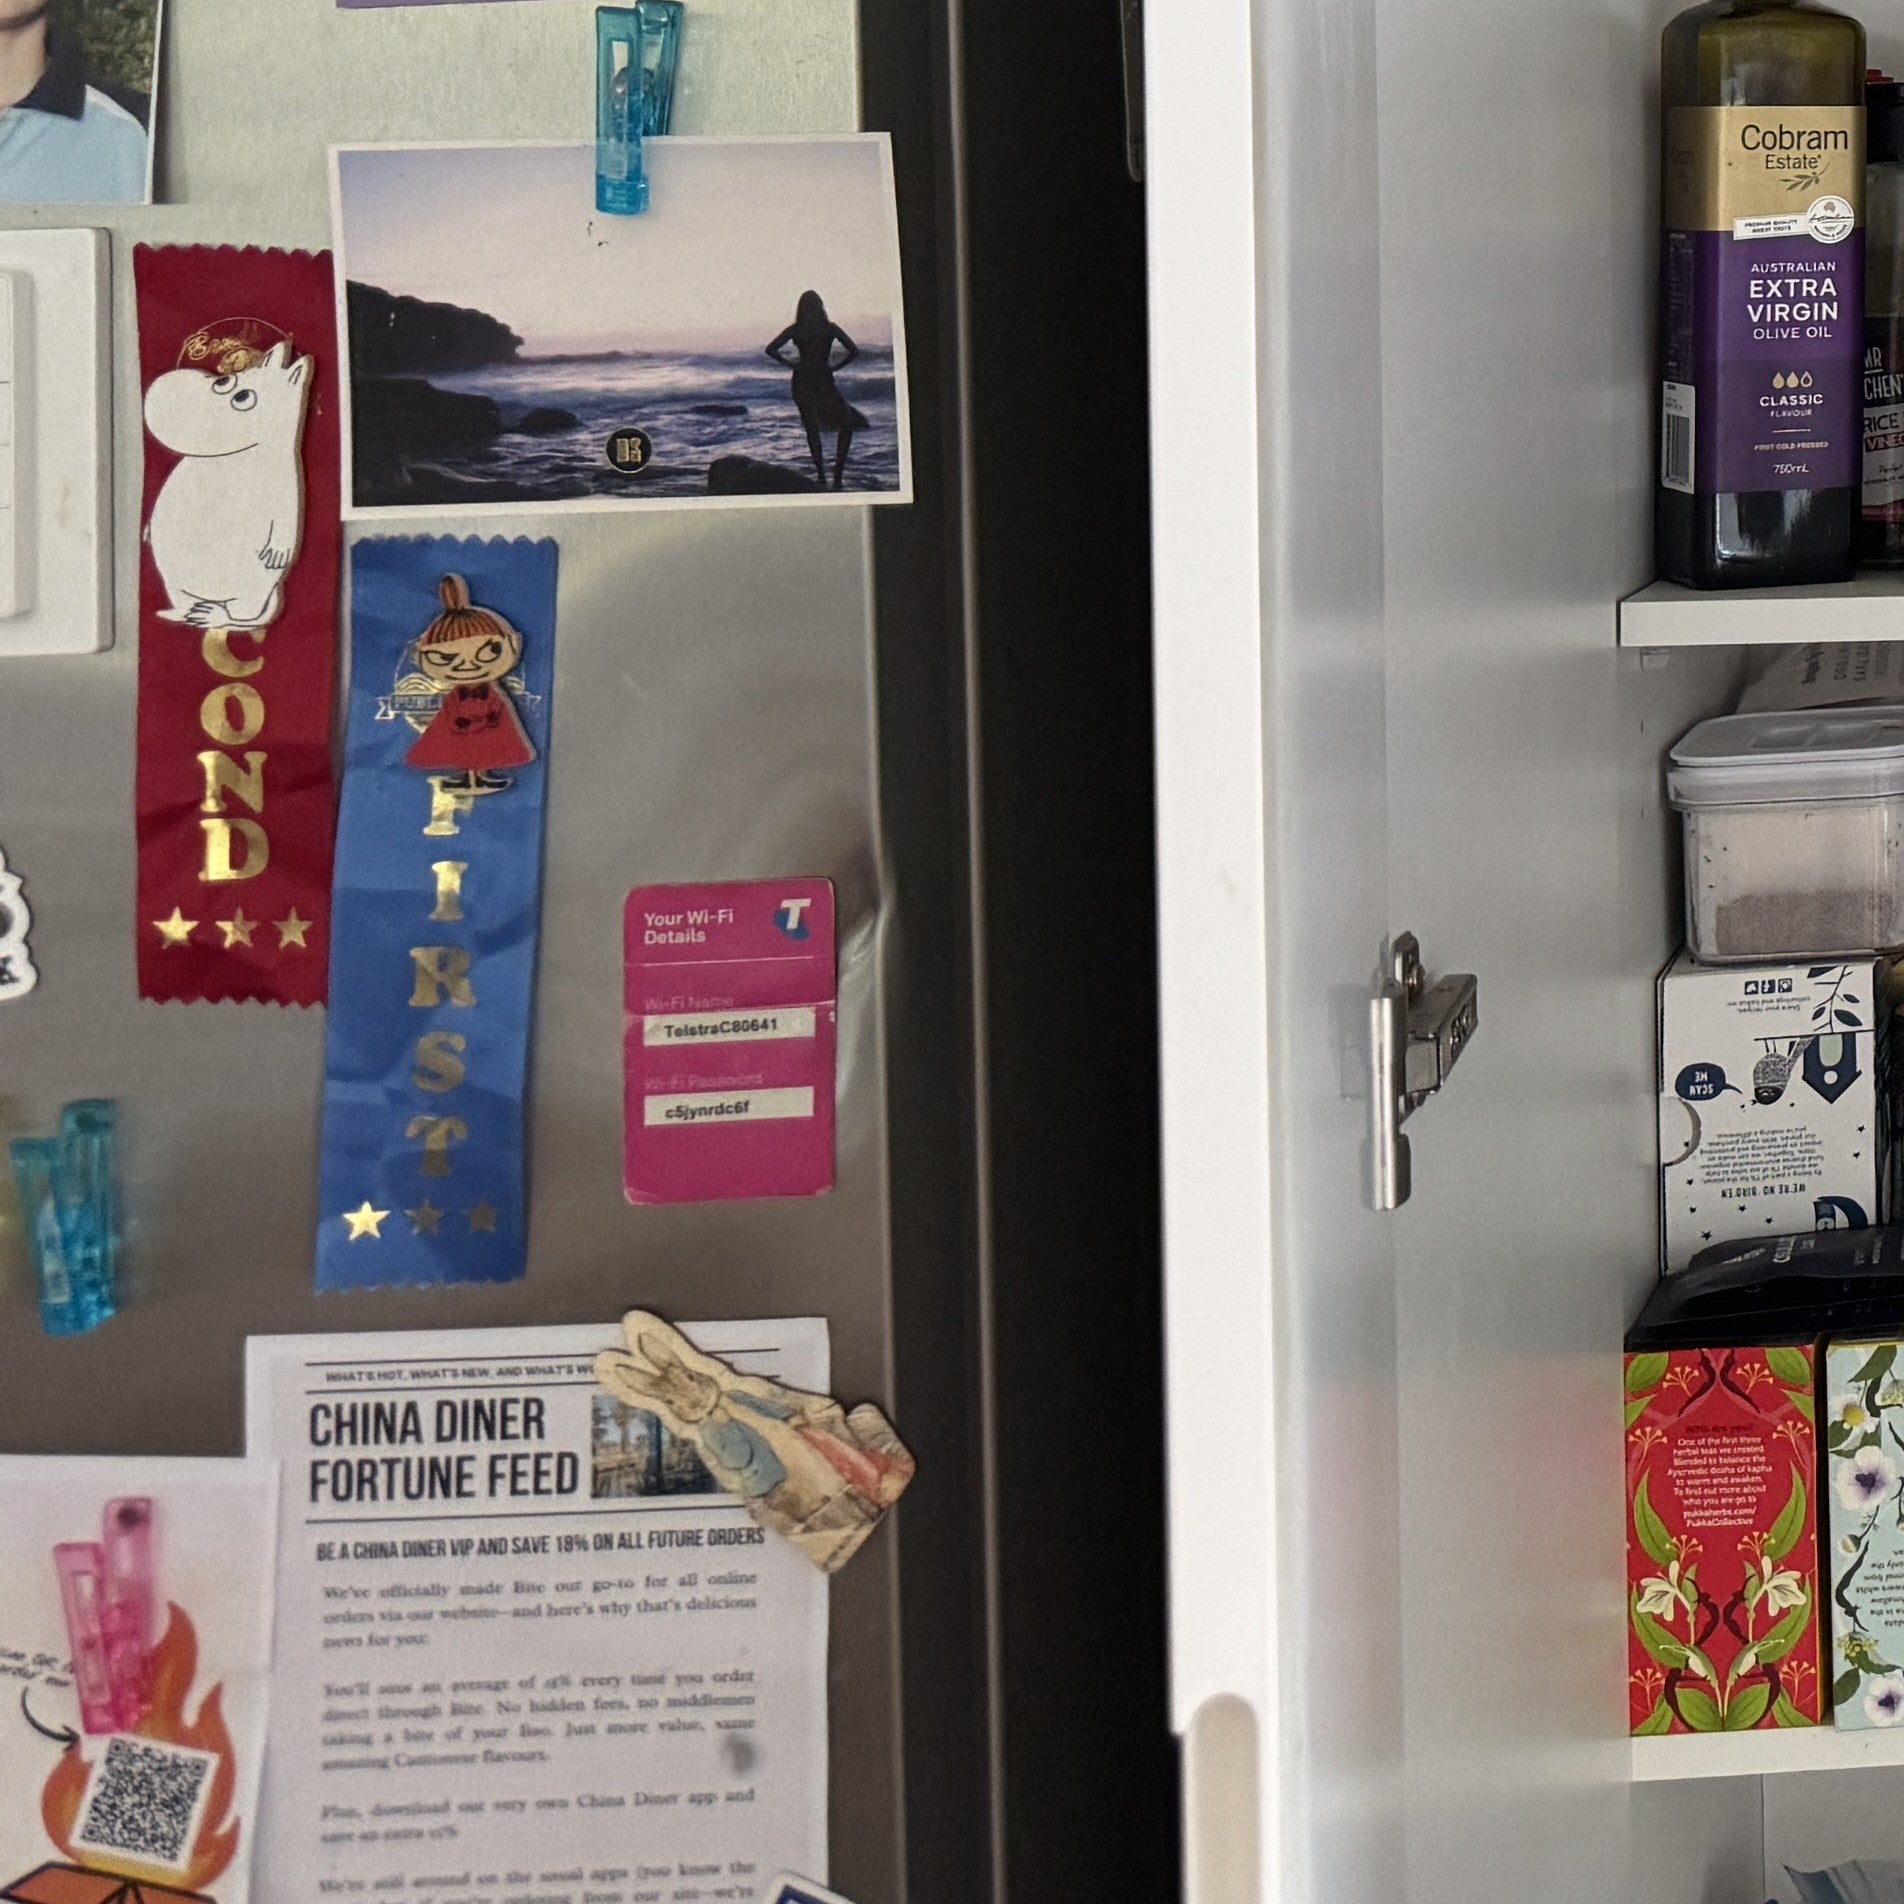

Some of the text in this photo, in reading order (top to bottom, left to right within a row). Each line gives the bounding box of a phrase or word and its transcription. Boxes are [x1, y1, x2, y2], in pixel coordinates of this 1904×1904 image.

[1741, 124, 1848, 151] Cobram
[1765, 154, 1817, 170] Estate
[1751, 262, 1836, 273] AUSTRALIAN
[1750, 279, 1837, 298] EXTRA
[1747, 302, 1839, 322] VIRGIN
[1753, 325, 1832, 340] OLIVE OIL
[1864, 347, 1882, 367] MR
[1759, 394, 1824, 407] CLASSIC
[1863, 414, 1898, 433] RICE
[197, 629, 271, 883] COND
[644, 909, 734, 928] Your Wi-Fi
[644, 929, 706, 945] Details
[407, 777, 473, 1179] FIRST
[1694, 1071, 1708, 1081] ME
[1690, 1084, 1713, 1095] SCAN
[1763, 1186, 1775, 1194] NO
[1779, 1183, 1806, 1196] WE'RE
[496, 1366, 523, 1377] AND
[309, 1397, 546, 1447] CHINA DINER
[309, 1451, 579, 1503] FORTUNE FEED
[316, 1527, 765, 1561] BE A CHINA DINER VIP AND SAVE 18% ON ALL FUTURE ORDERS
[644, 1570, 757, 1589] for all online
[547, 1596, 757, 1618] here's why that's delicious
